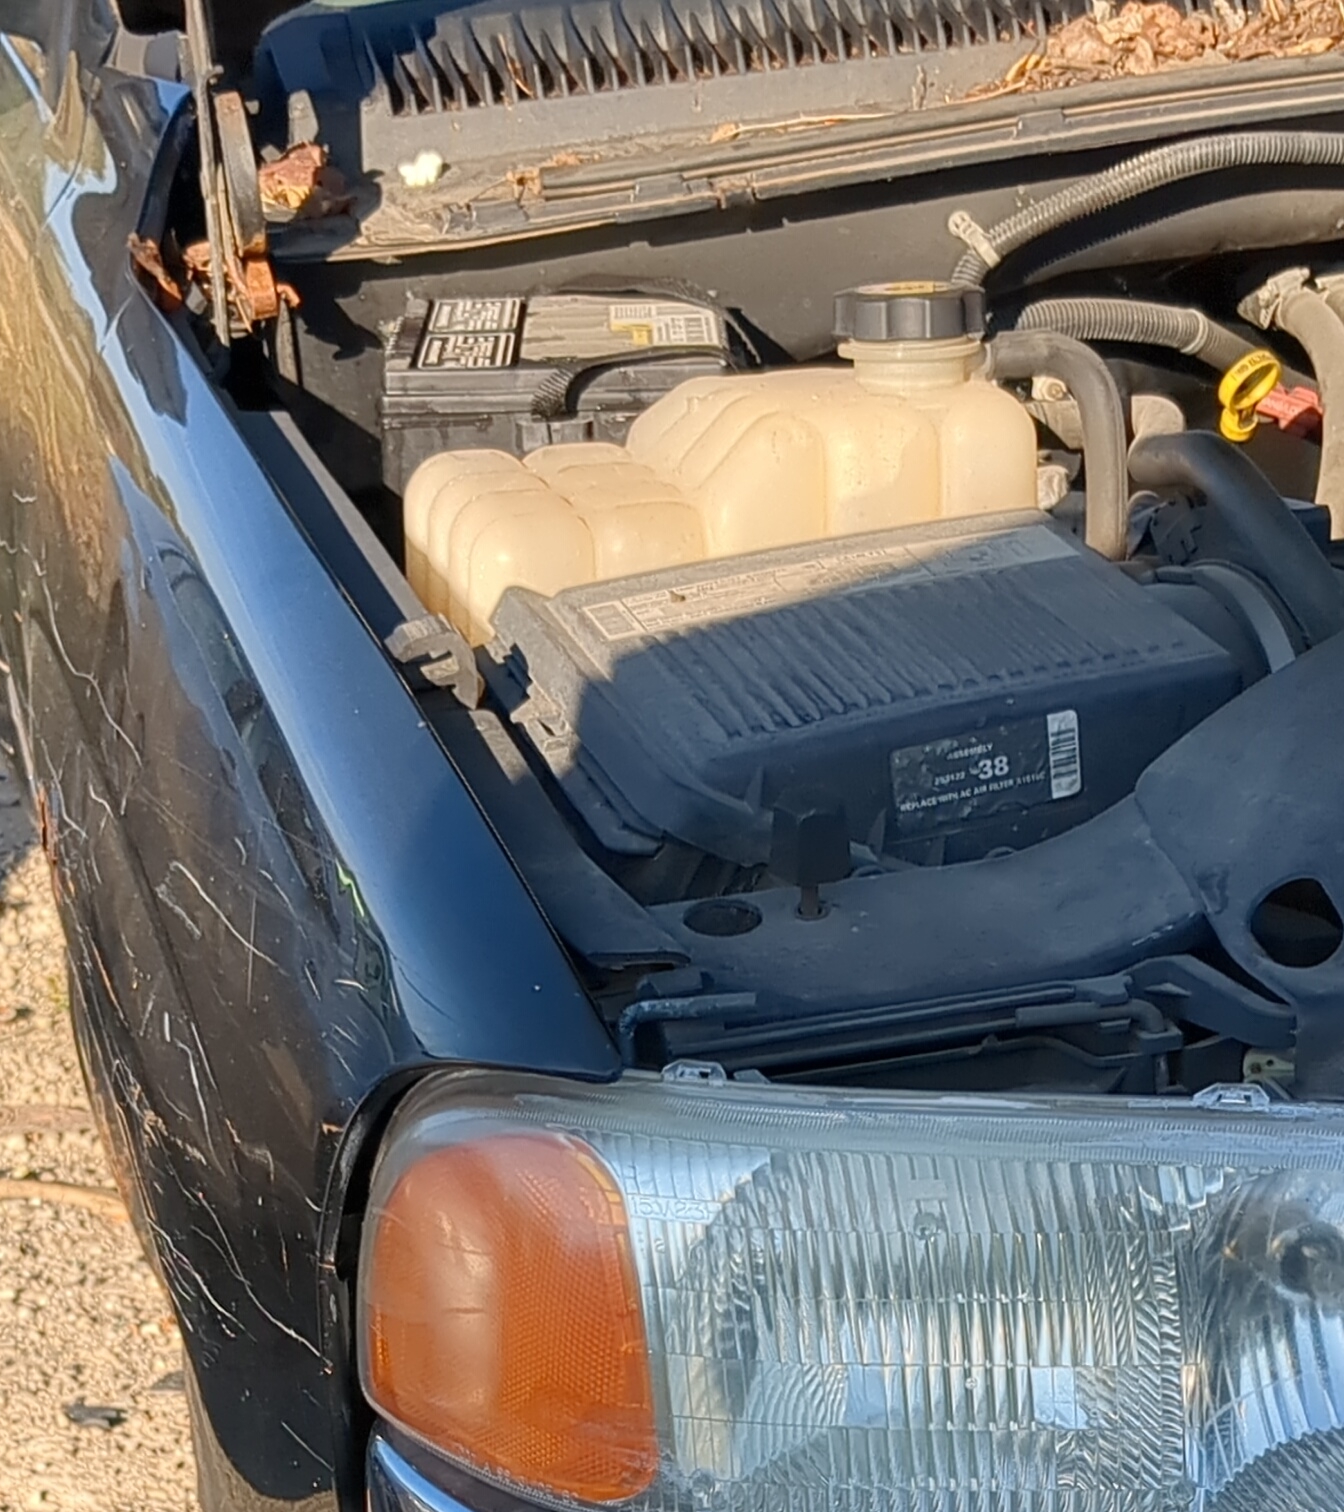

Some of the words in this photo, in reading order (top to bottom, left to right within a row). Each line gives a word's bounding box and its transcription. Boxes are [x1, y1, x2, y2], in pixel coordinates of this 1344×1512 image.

[978, 756, 1009, 780] 38
[900, 796, 937, 812] REPLACE
[938, 791, 959, 803] WITH
[960, 788, 972, 799] AC
[973, 785, 987, 796] AIR
[989, 778, 1014, 792] FILTER
